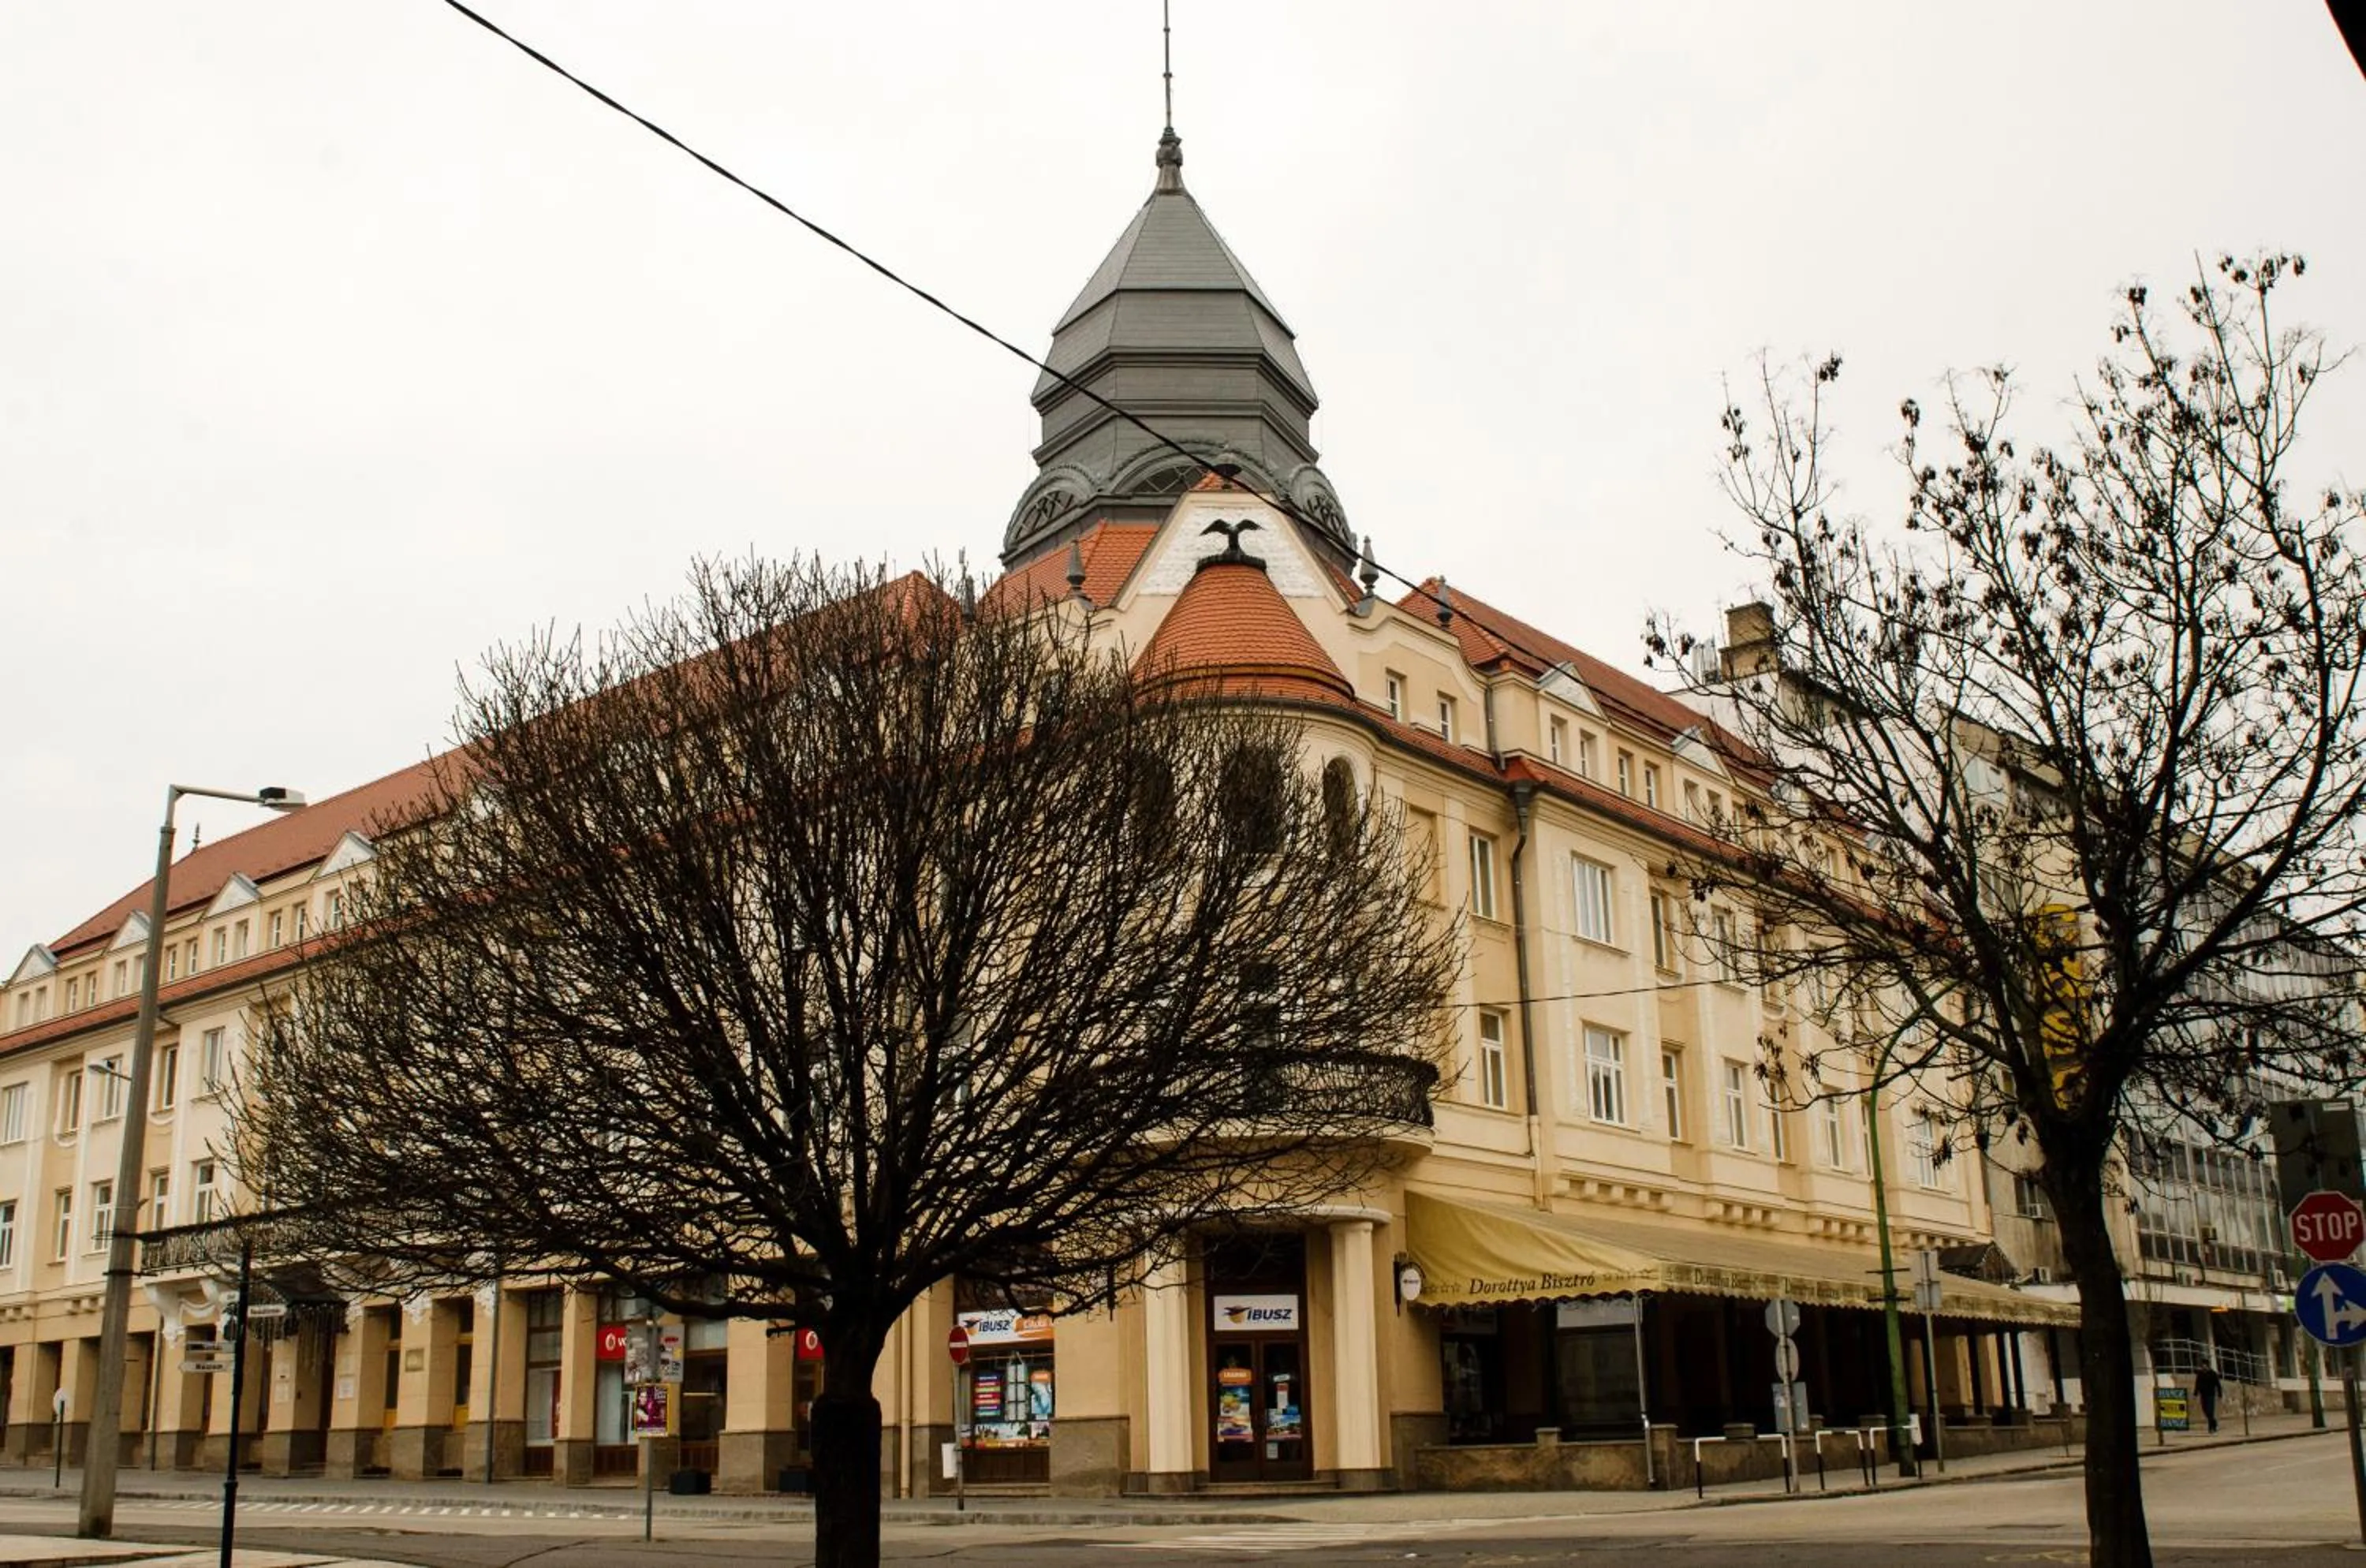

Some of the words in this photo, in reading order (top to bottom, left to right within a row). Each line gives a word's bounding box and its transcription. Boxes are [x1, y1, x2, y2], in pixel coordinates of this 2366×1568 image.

[2296, 1211, 2358, 1242] STOP
[1540, 1271, 1595, 1290] Bisztró
[1247, 1308, 1293, 1321] IBUSZ
[979, 1320, 1010, 1332] IBUSZ
